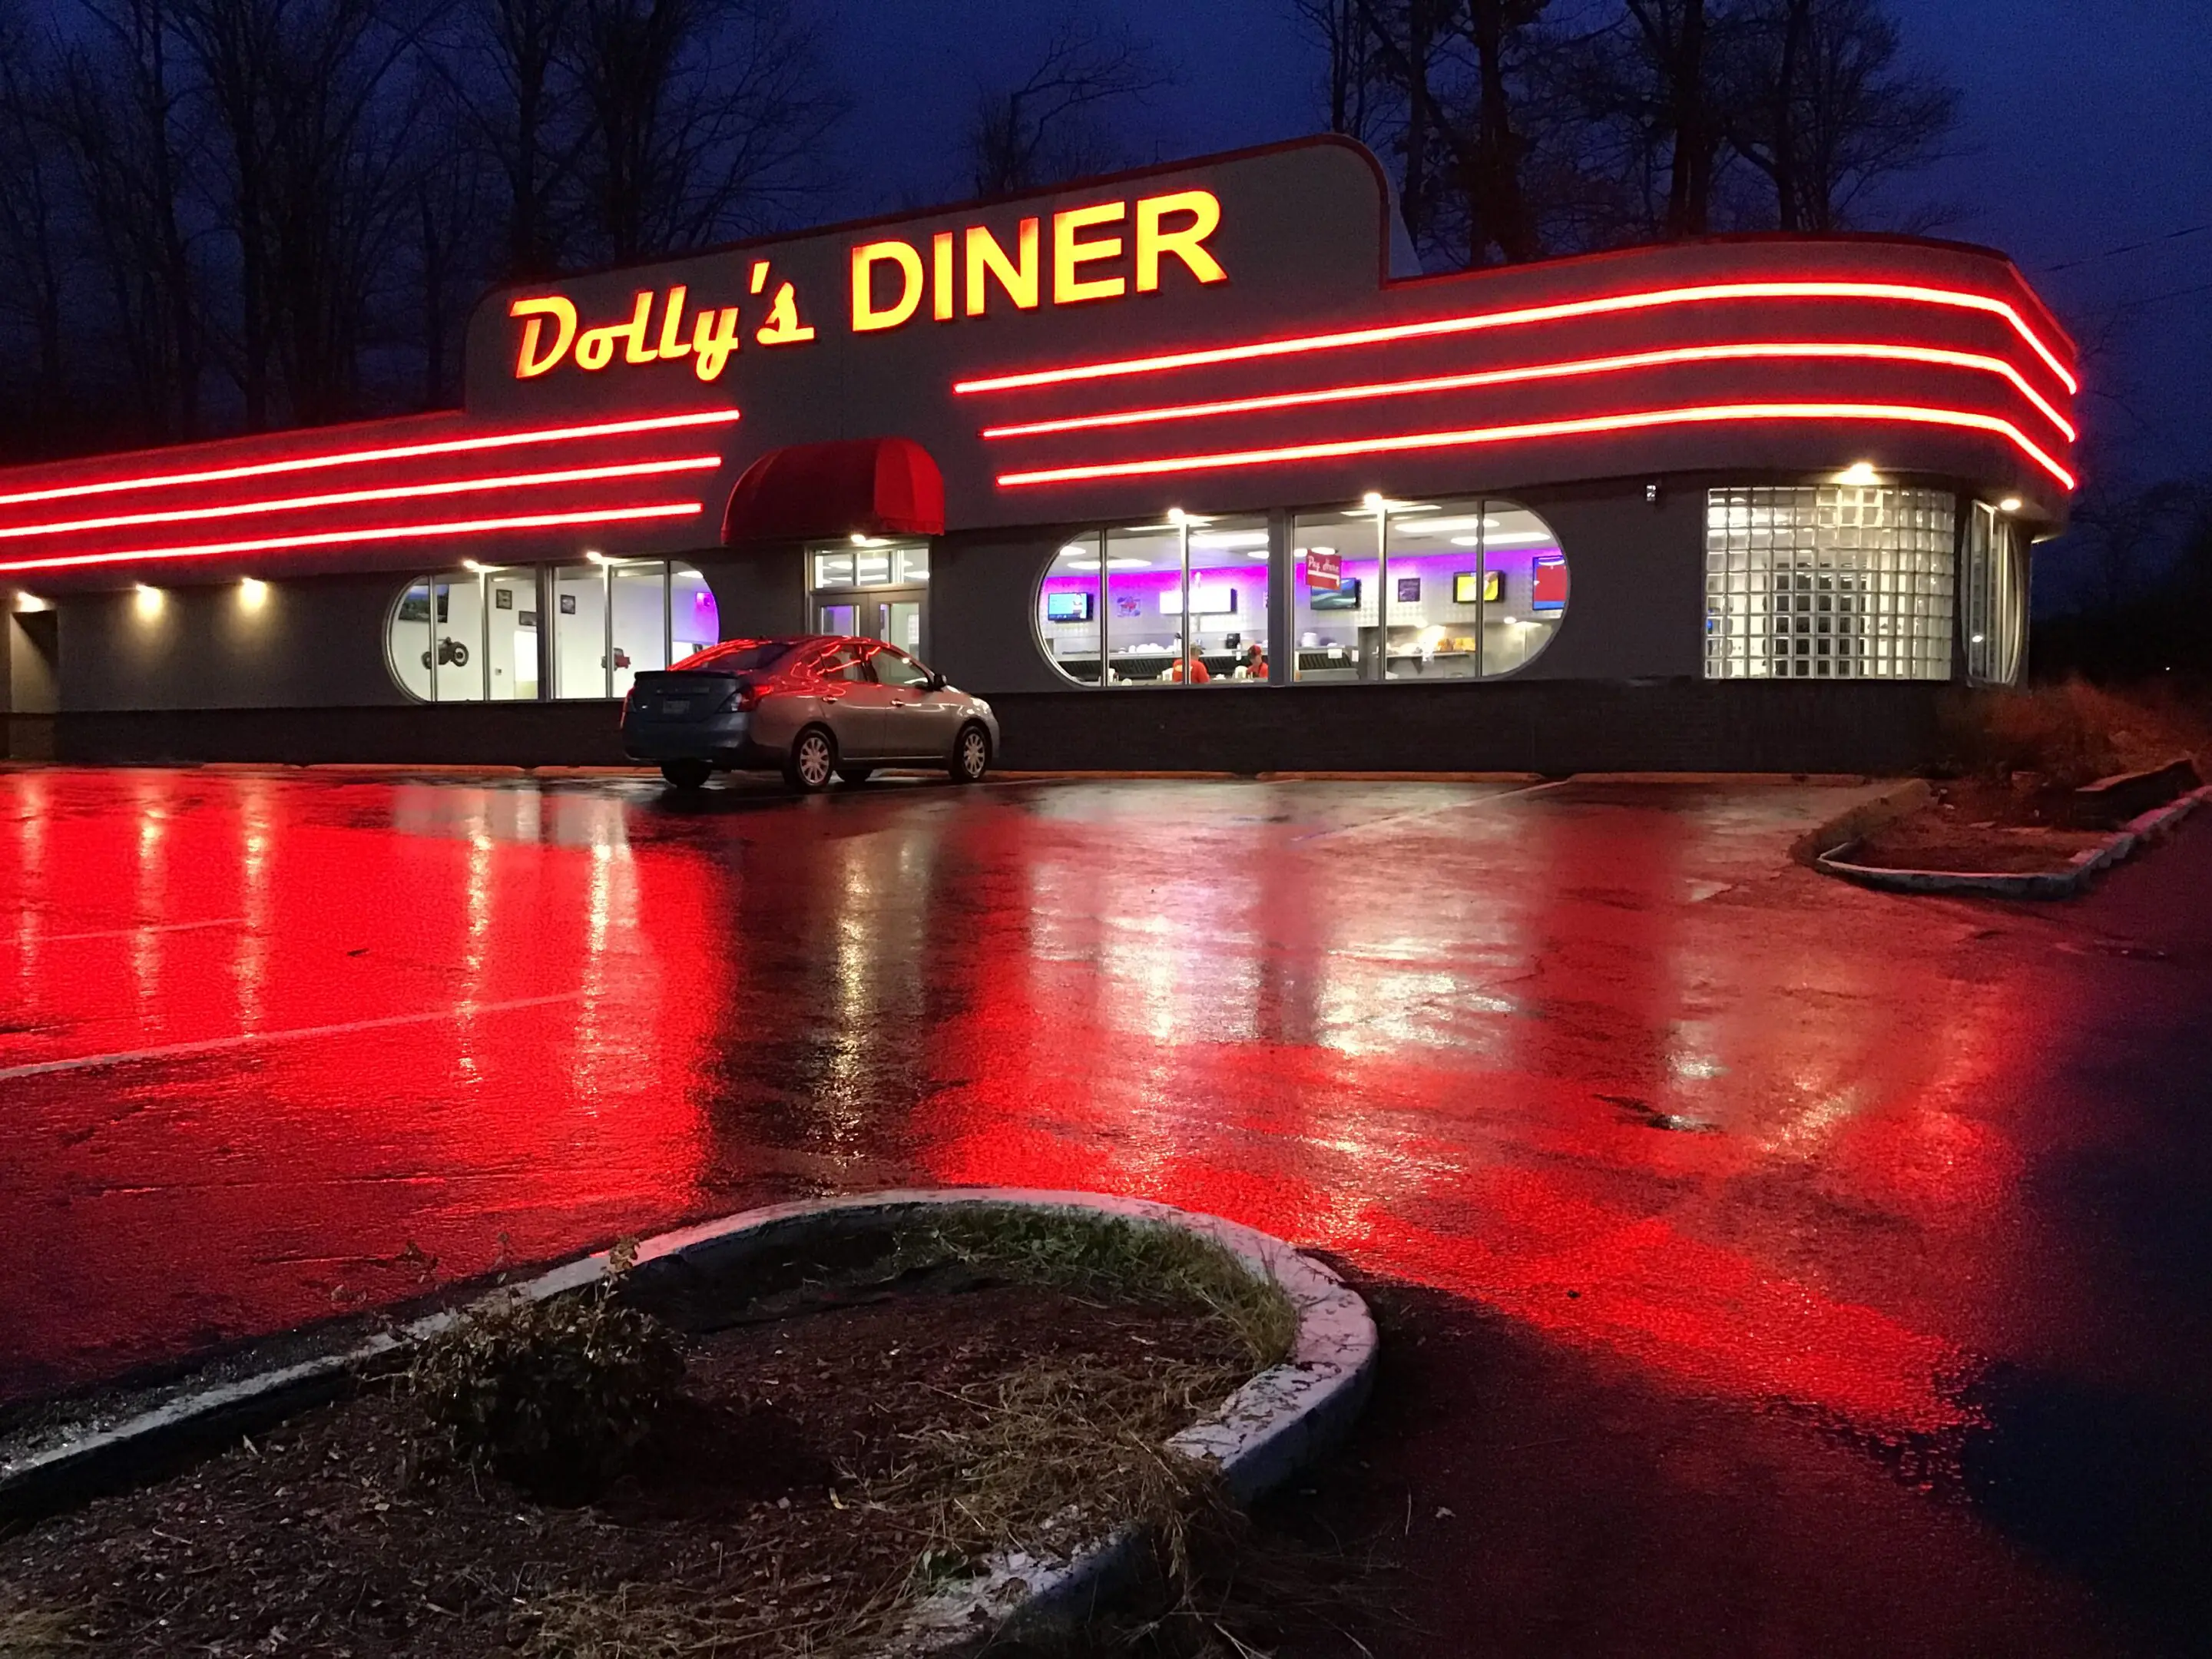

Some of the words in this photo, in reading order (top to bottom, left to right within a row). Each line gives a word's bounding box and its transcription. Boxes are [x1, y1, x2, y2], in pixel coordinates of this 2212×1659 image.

[510, 261, 816, 381] Dolly's
[850, 190, 1227, 333] DINER
[1308, 555, 1320, 571] Pay
